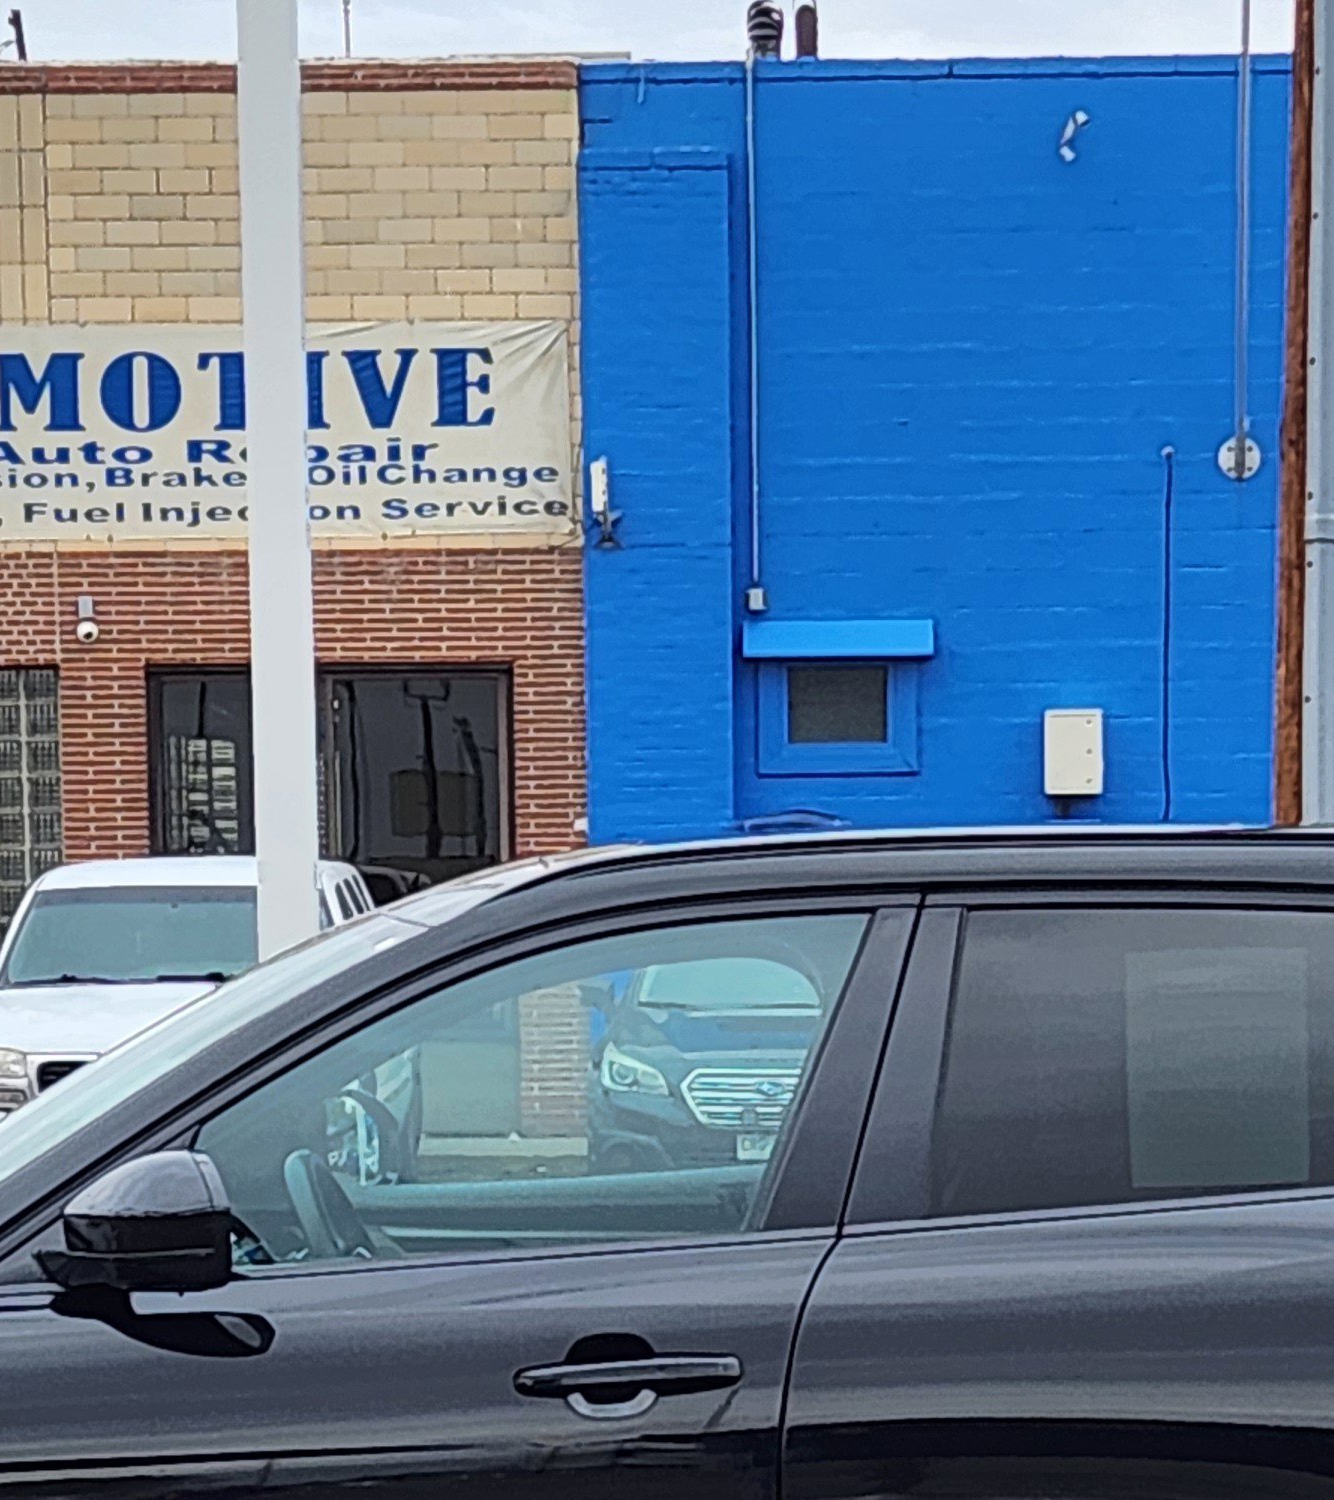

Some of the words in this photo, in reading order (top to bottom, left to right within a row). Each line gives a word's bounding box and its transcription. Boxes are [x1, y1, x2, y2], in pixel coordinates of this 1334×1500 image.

[186, 437, 439, 464] Rair
[23, 502, 125, 523] Fuel
[141, 501, 361, 528] Injeon
[381, 495, 570, 521] Service
